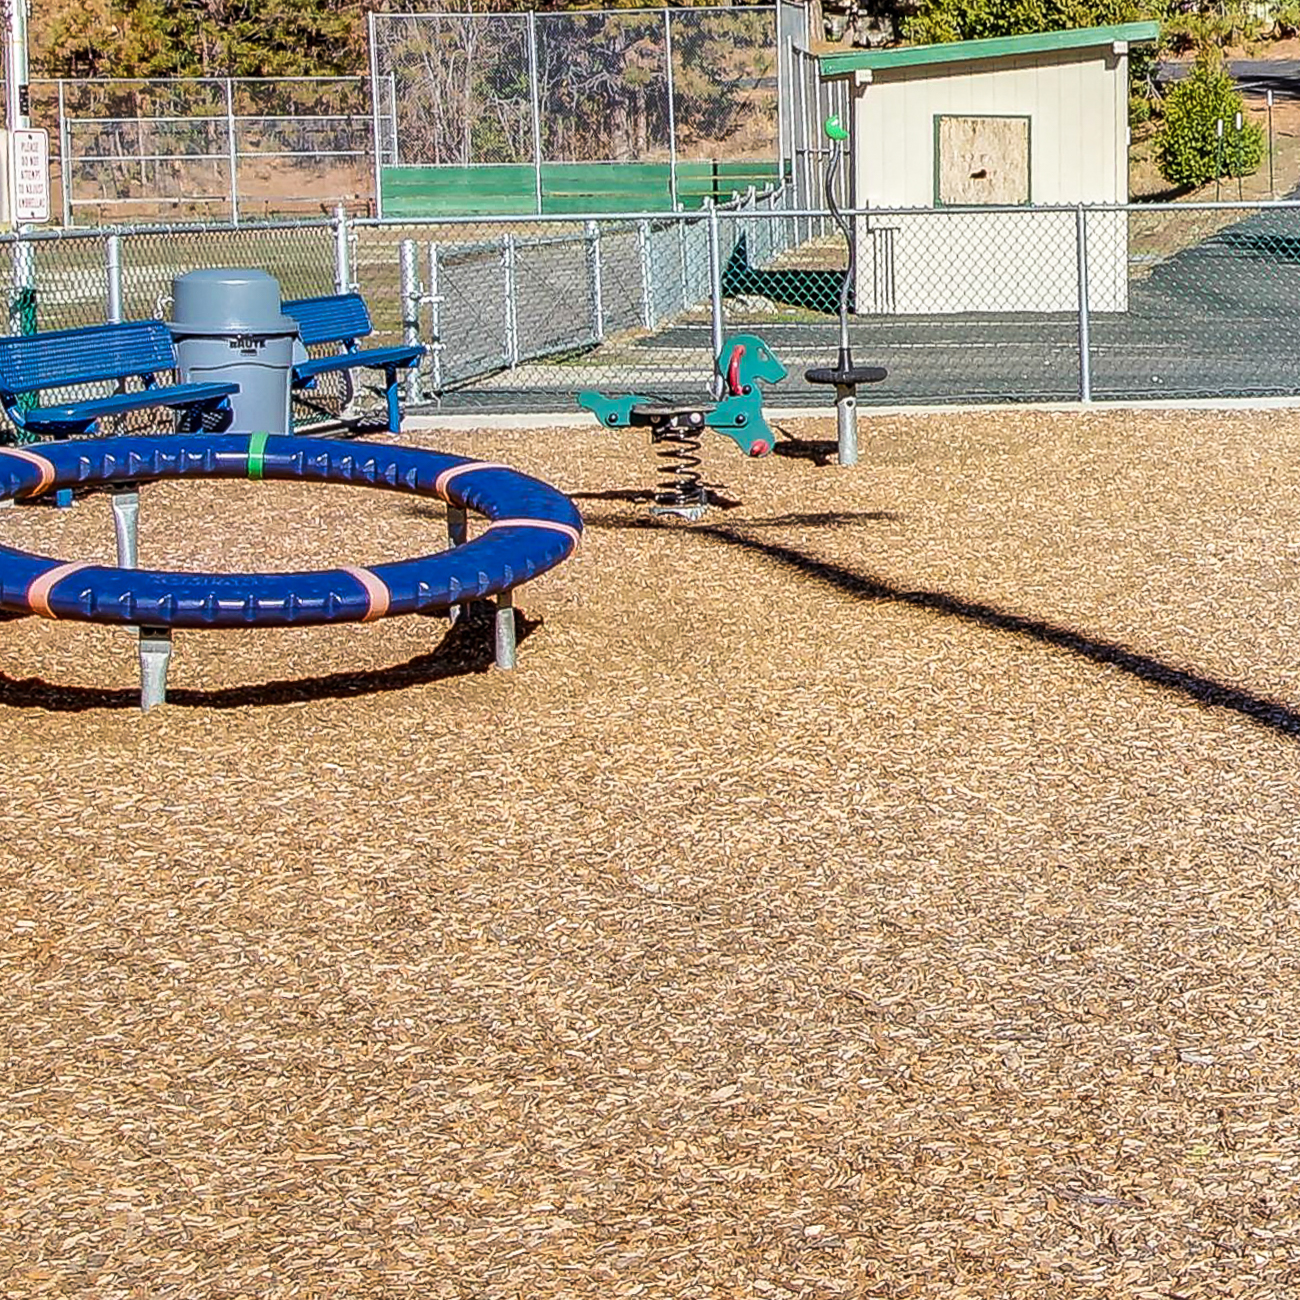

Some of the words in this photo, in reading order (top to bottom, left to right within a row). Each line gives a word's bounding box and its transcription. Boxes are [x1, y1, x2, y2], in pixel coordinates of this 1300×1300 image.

[21, 142, 39, 152] PLEASE
[21, 156, 28, 166] DO
[29, 156, 39, 166] NOT
[18, 183, 24, 194] TO
